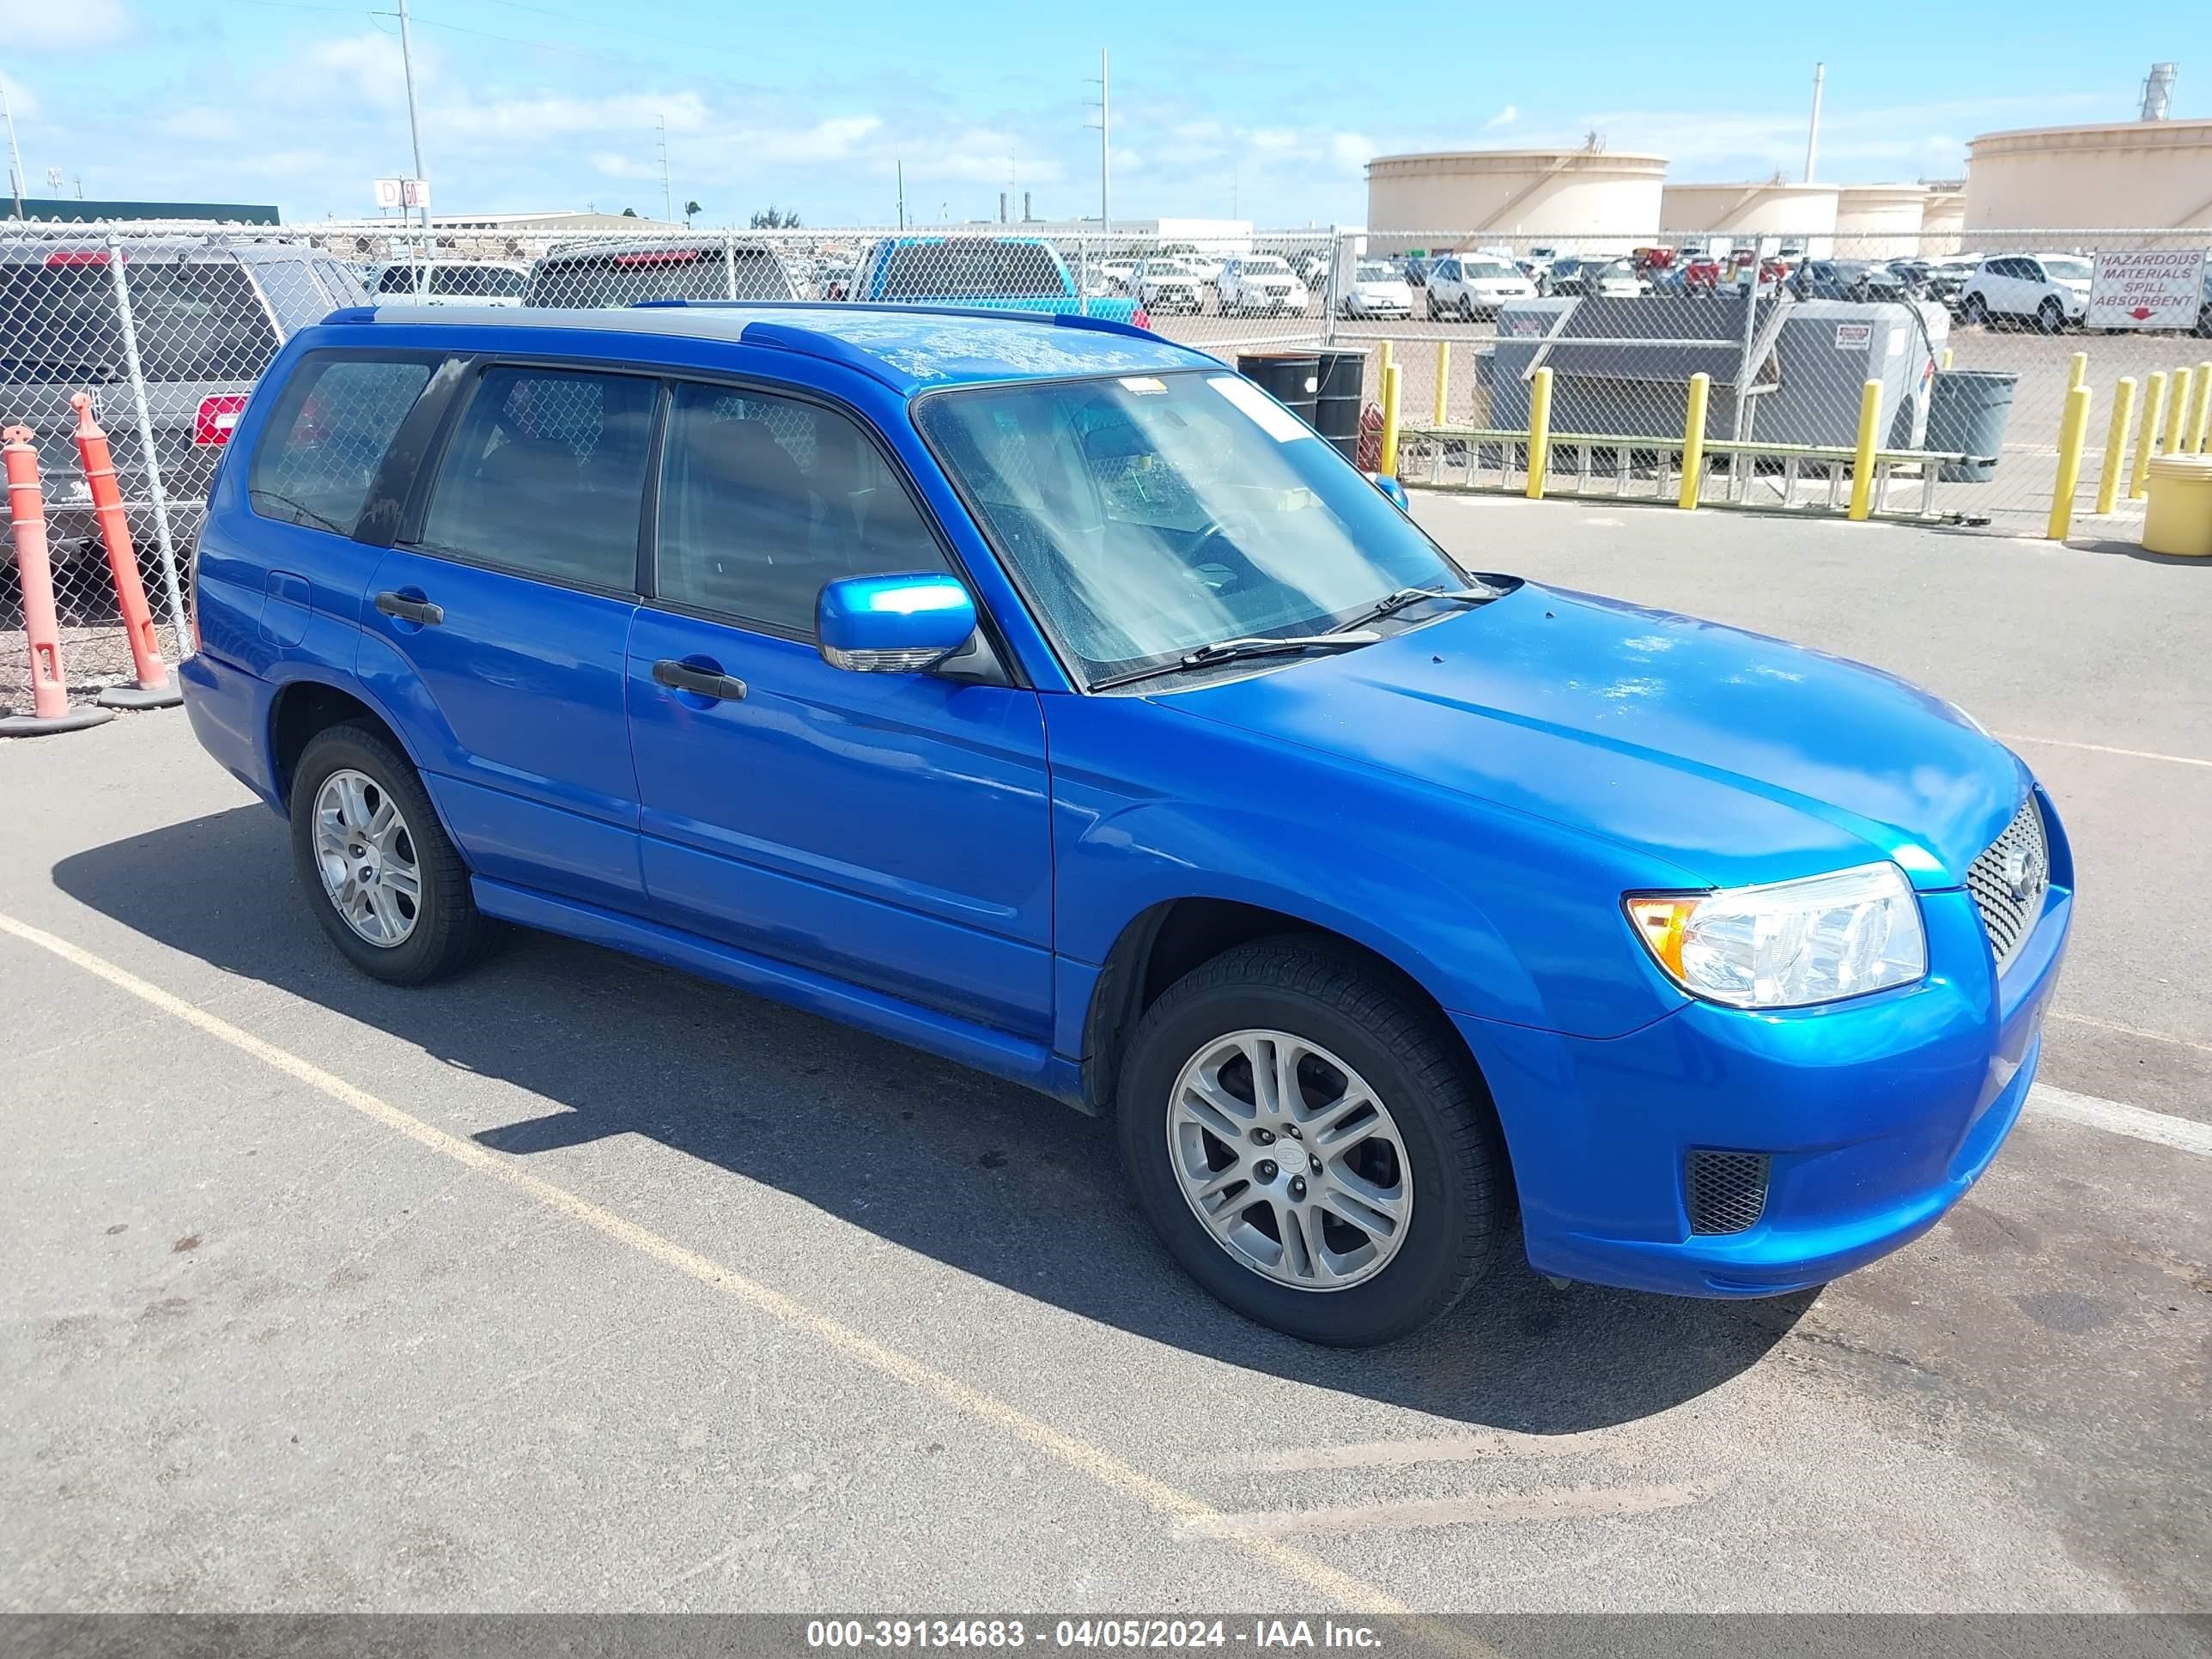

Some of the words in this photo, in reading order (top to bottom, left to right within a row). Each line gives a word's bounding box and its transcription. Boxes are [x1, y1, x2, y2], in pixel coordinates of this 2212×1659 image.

[2100, 253, 2199, 266] HAZARDOUS
[2103, 268, 2192, 279] MATERIALS
[2124, 282, 2166, 293] SPILL
[2094, 295, 2194, 307] ABSORBENT
